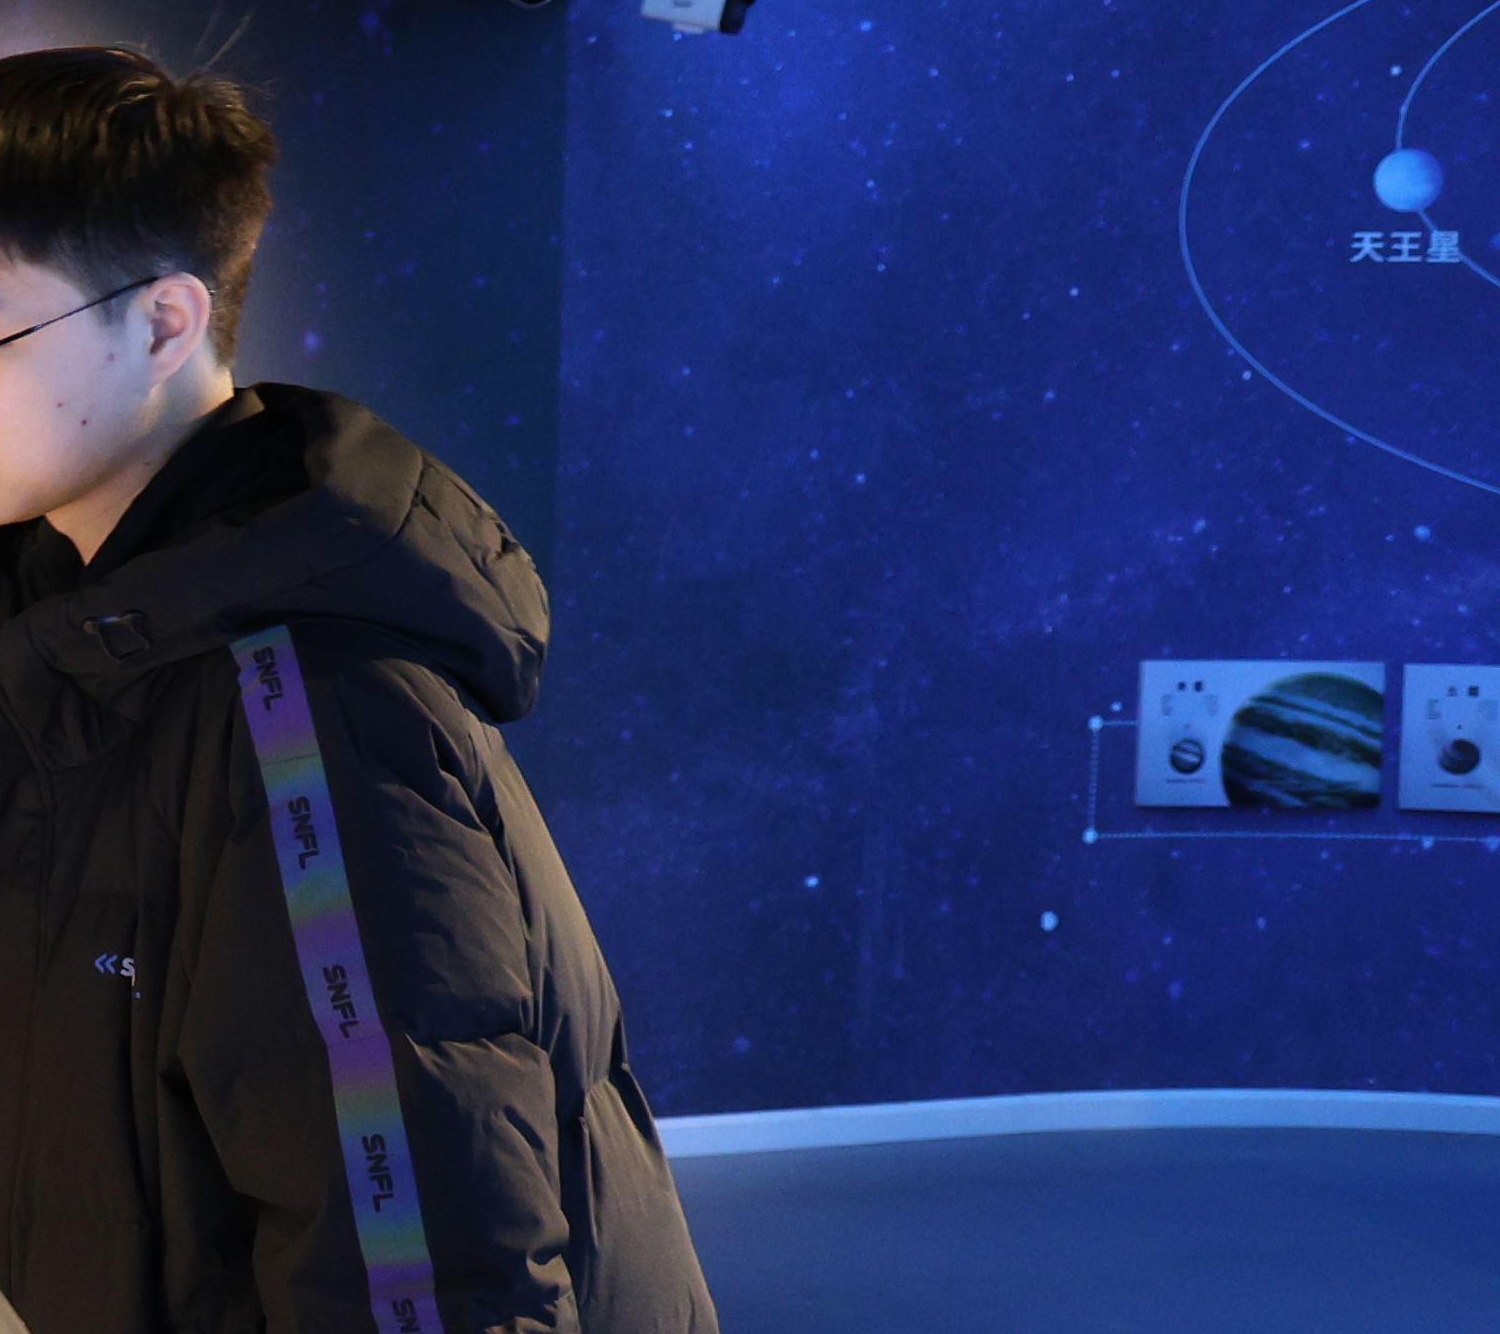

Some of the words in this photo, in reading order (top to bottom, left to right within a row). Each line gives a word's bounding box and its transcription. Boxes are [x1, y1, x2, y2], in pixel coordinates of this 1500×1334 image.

[1350, 229, 1462, 263] 天王星
[252, 646, 285, 711] SNFL
[287, 795, 320, 871] SNFL
[322, 963, 360, 1039] SNFL
[361, 1133, 395, 1213] SNFL
